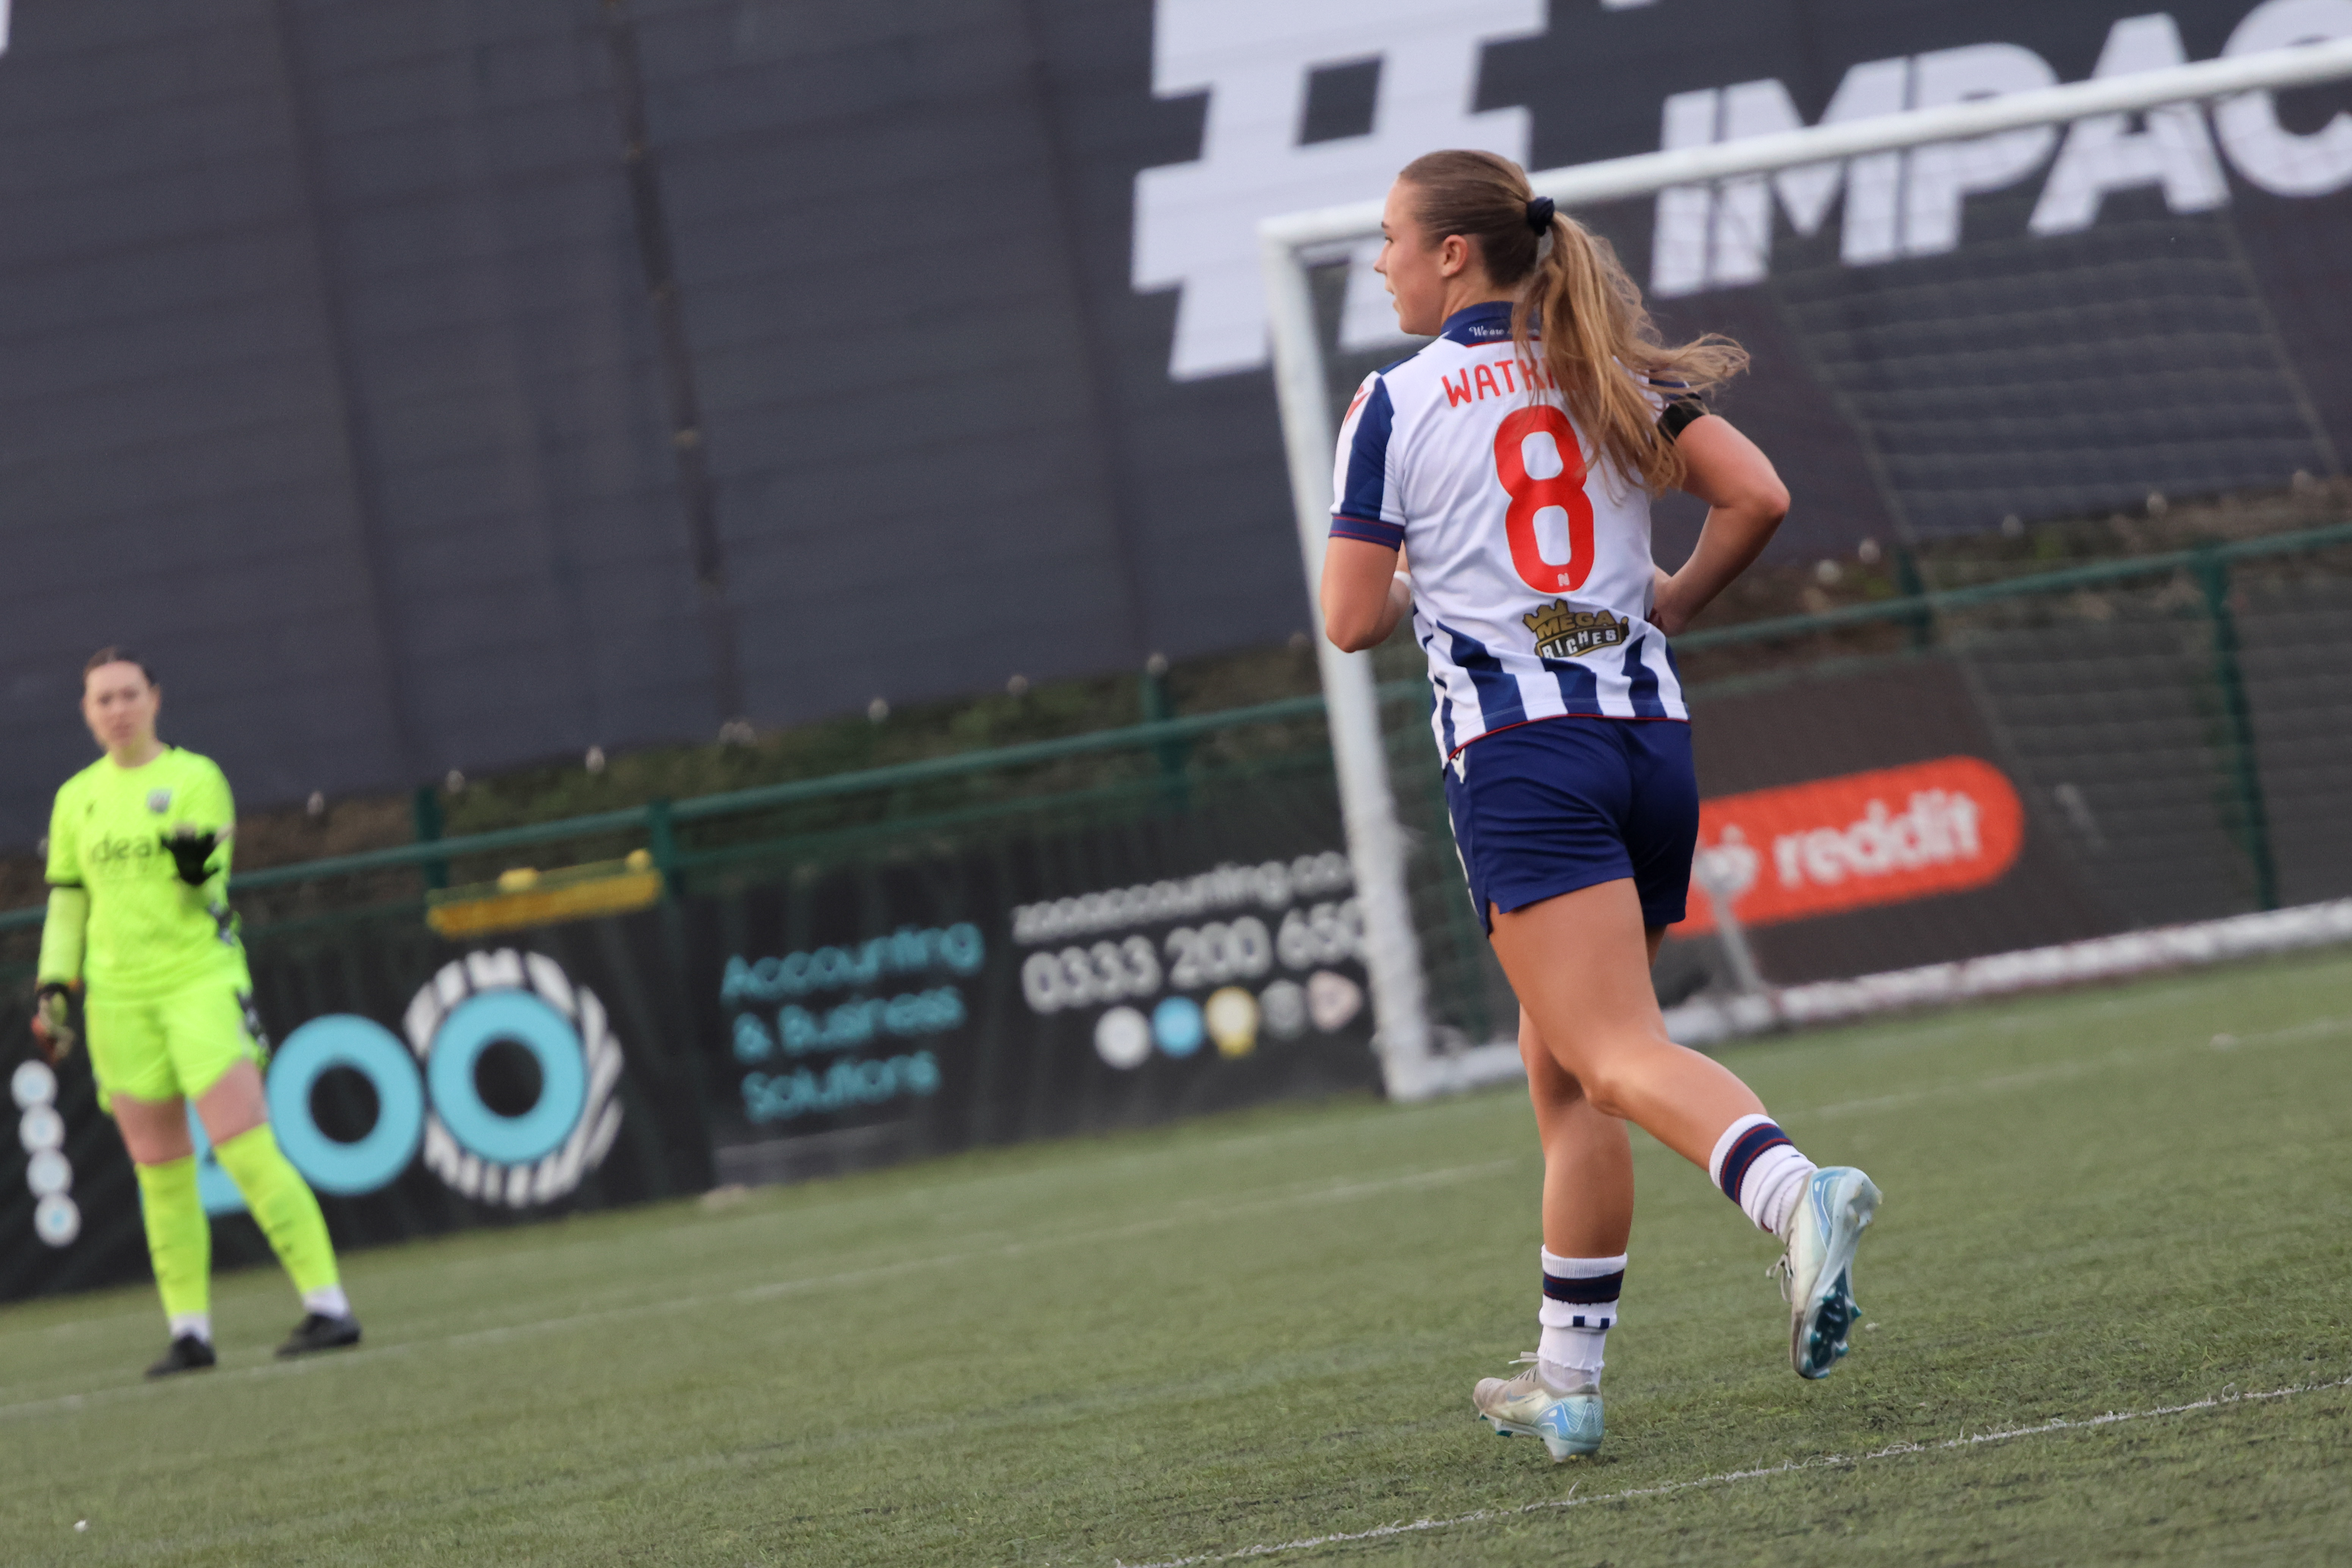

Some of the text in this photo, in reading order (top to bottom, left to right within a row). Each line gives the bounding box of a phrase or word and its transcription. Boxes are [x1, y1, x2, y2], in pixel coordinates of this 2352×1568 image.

[1468, 325, 1488, 337] We
[1441, 357, 1556, 407] WATKI
[1493, 405, 1595, 594] 8
[1536, 609, 1617, 642] MEGA
[1541, 629, 1617, 659] RICHES
[1773, 788, 1979, 889] reddit
[721, 923, 984, 1002] Accounting
[1021, 934, 1162, 1014] 0333
[1165, 915, 1272, 989] 200
